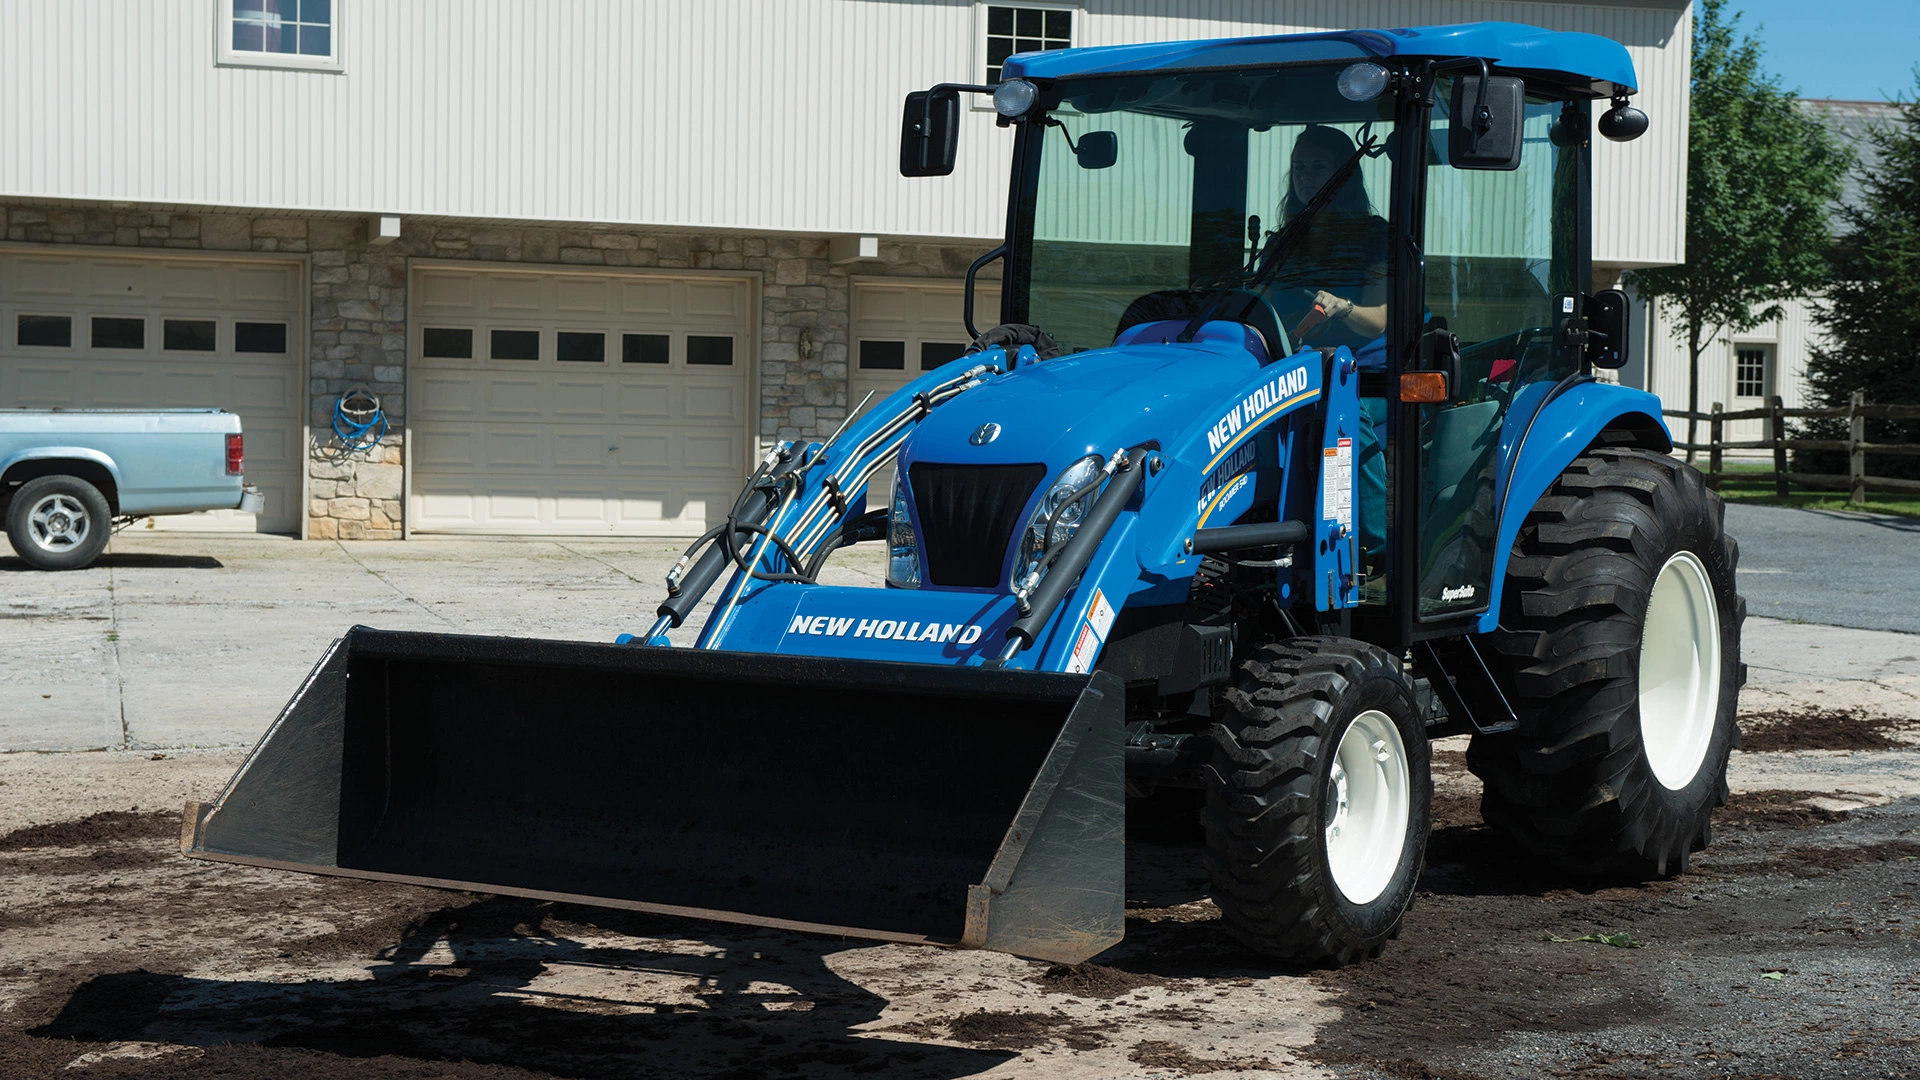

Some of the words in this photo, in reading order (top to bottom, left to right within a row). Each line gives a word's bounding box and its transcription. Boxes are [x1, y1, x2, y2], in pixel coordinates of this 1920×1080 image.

[1207, 404, 1242, 455] NEW
[1243, 366, 1308, 423] HOLLAND
[1217, 440, 1256, 490] HOLLAND
[1218, 482, 1240, 512] BOOMER
[1441, 584, 1475, 603] SuperSuite
[788, 614, 855, 637] NEW
[854, 618, 983, 645] HOLLAND
